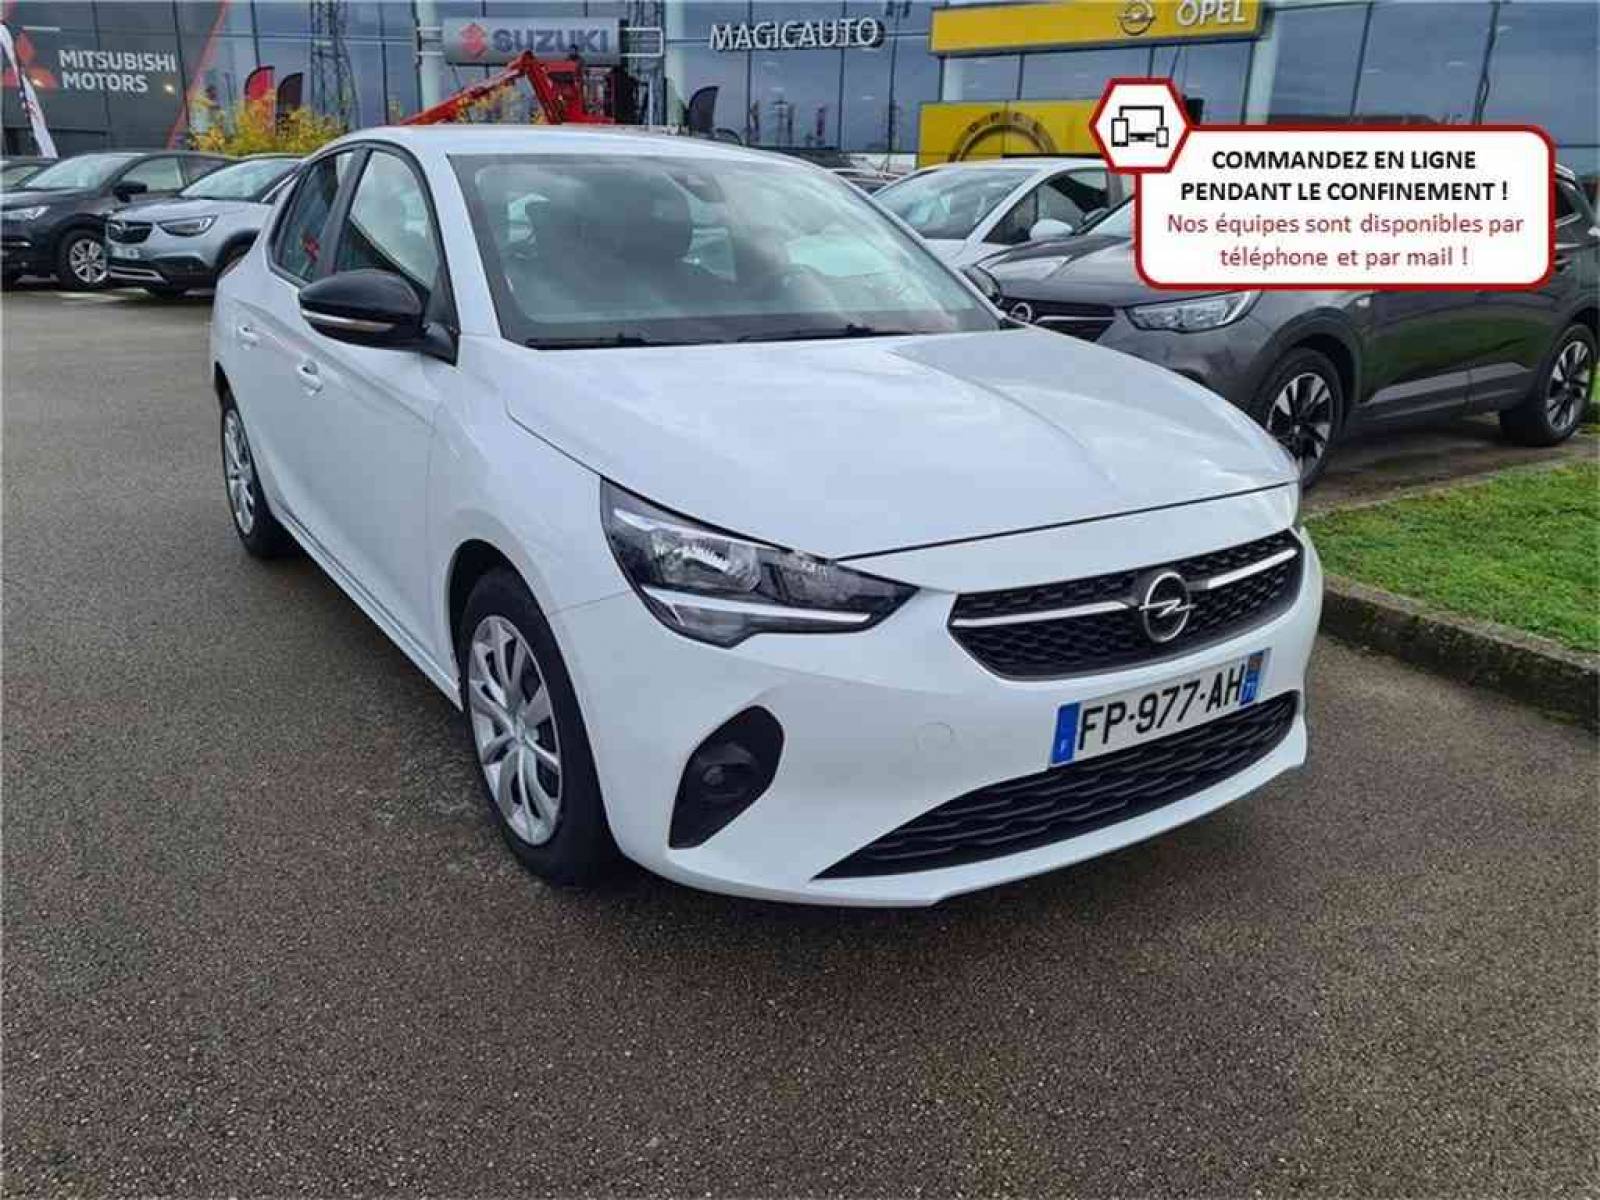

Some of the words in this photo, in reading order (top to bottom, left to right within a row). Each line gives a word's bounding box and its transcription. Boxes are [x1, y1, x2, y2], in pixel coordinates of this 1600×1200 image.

[1177, 0, 1246, 26] OPEL
[493, 28, 609, 53] SUZUKI
[710, 18, 878, 50] MAGICAUTO
[59, 50, 176, 72] MITSUBISHI
[61, 71, 148, 92] MOTORS
[1079, 664, 1246, 750] FP-977-AH
